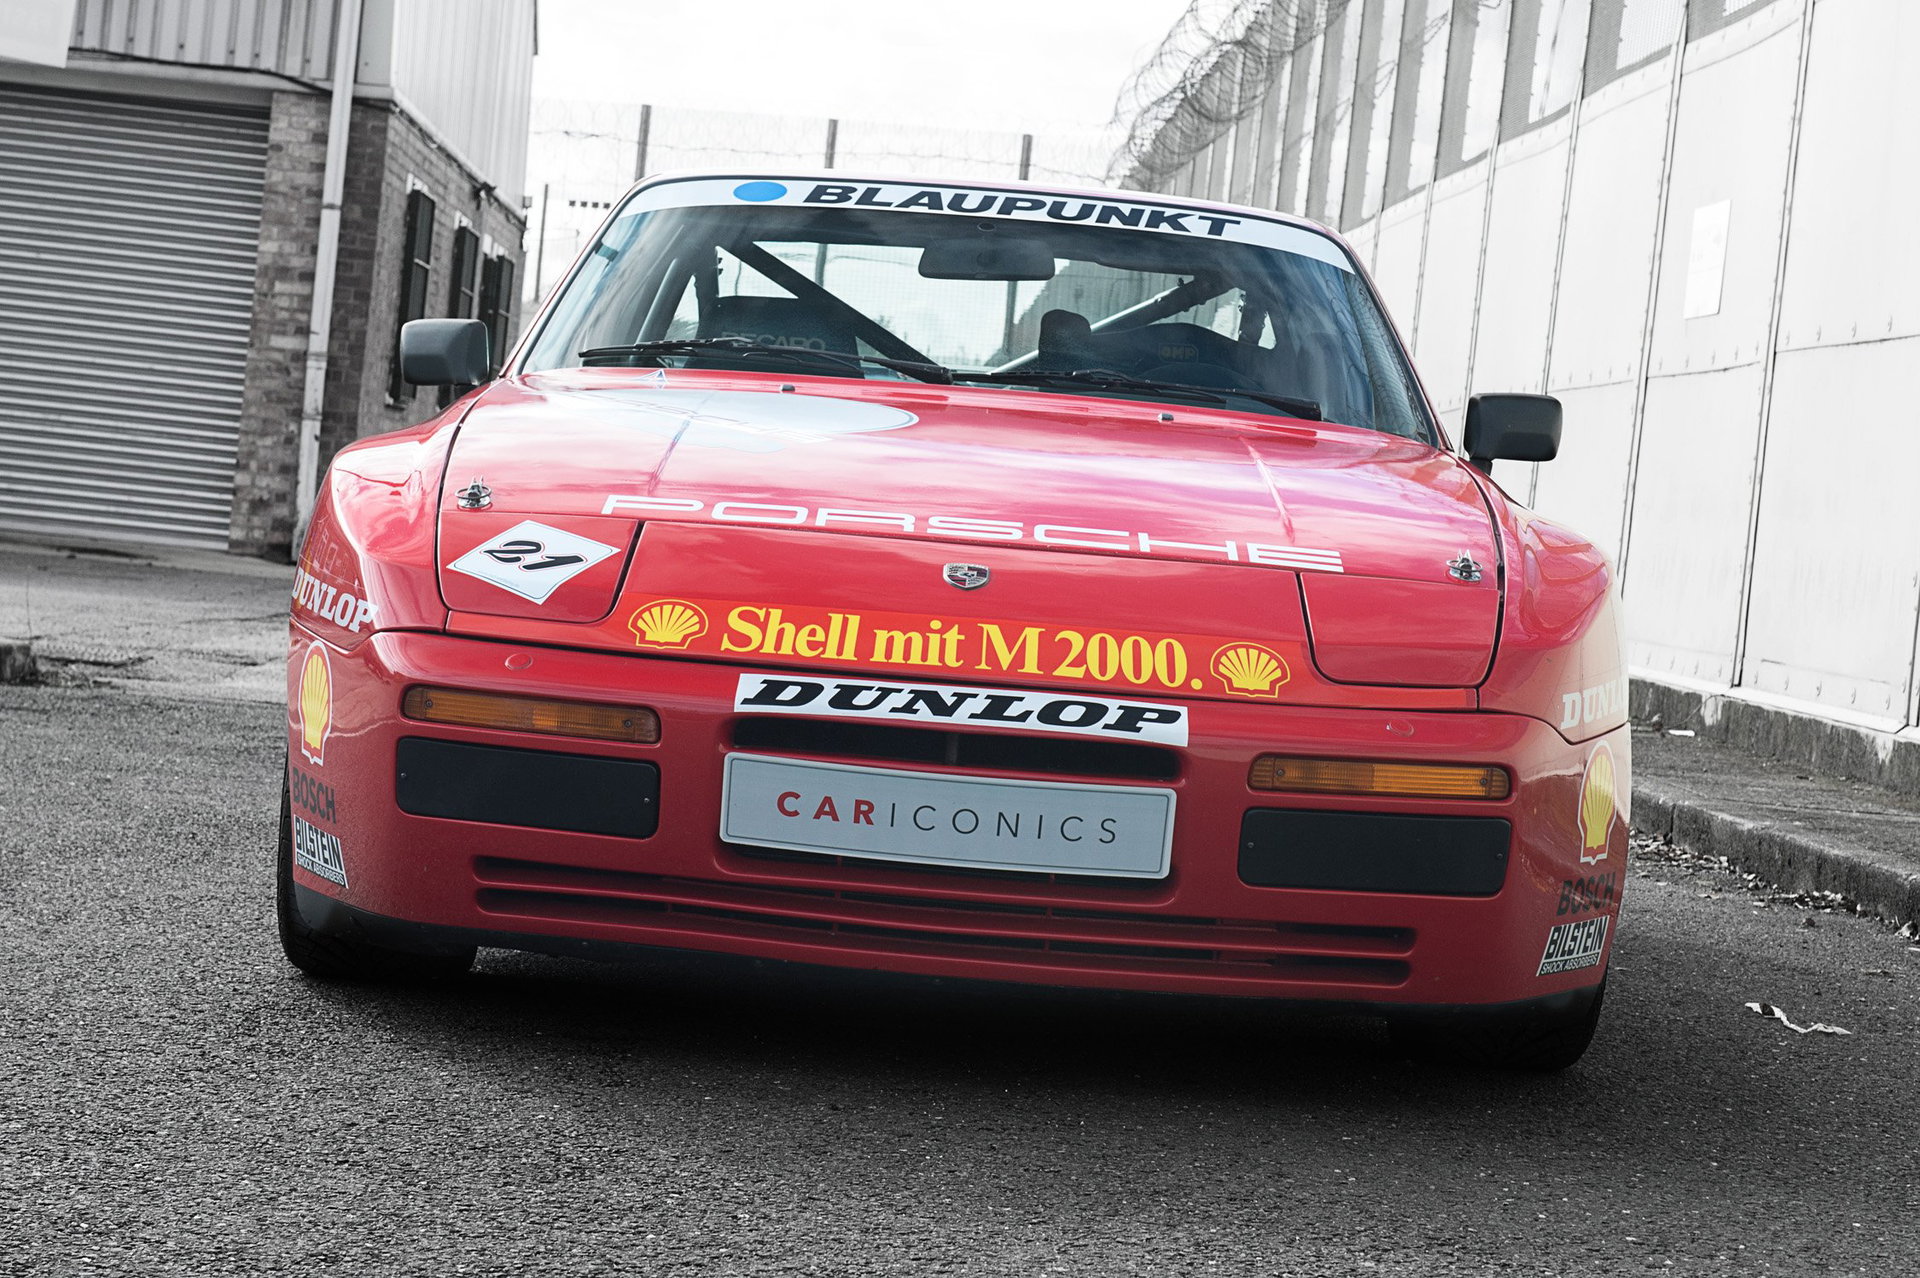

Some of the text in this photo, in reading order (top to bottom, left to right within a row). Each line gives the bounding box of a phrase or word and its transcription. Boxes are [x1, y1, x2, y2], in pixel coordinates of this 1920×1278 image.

[803, 184, 1241, 236] BLAUPUNKT
[481, 540, 586, 571] 21
[601, 494, 1344, 573] PORSCHE
[292, 567, 378, 633] DUNLOP
[720, 605, 1204, 690] Shell mit M 2000.
[739, 678, 1182, 733] DUNLOP
[292, 767, 337, 824] BOSCH
[776, 790, 1117, 844] CARICONICS
[295, 816, 344, 871] BILSTEIN
[1556, 872, 1616, 917] BOSCH
[1541, 953, 1598, 975] SHOCK ABSORBERS
[1544, 916, 1607, 960] BILSTEIN
